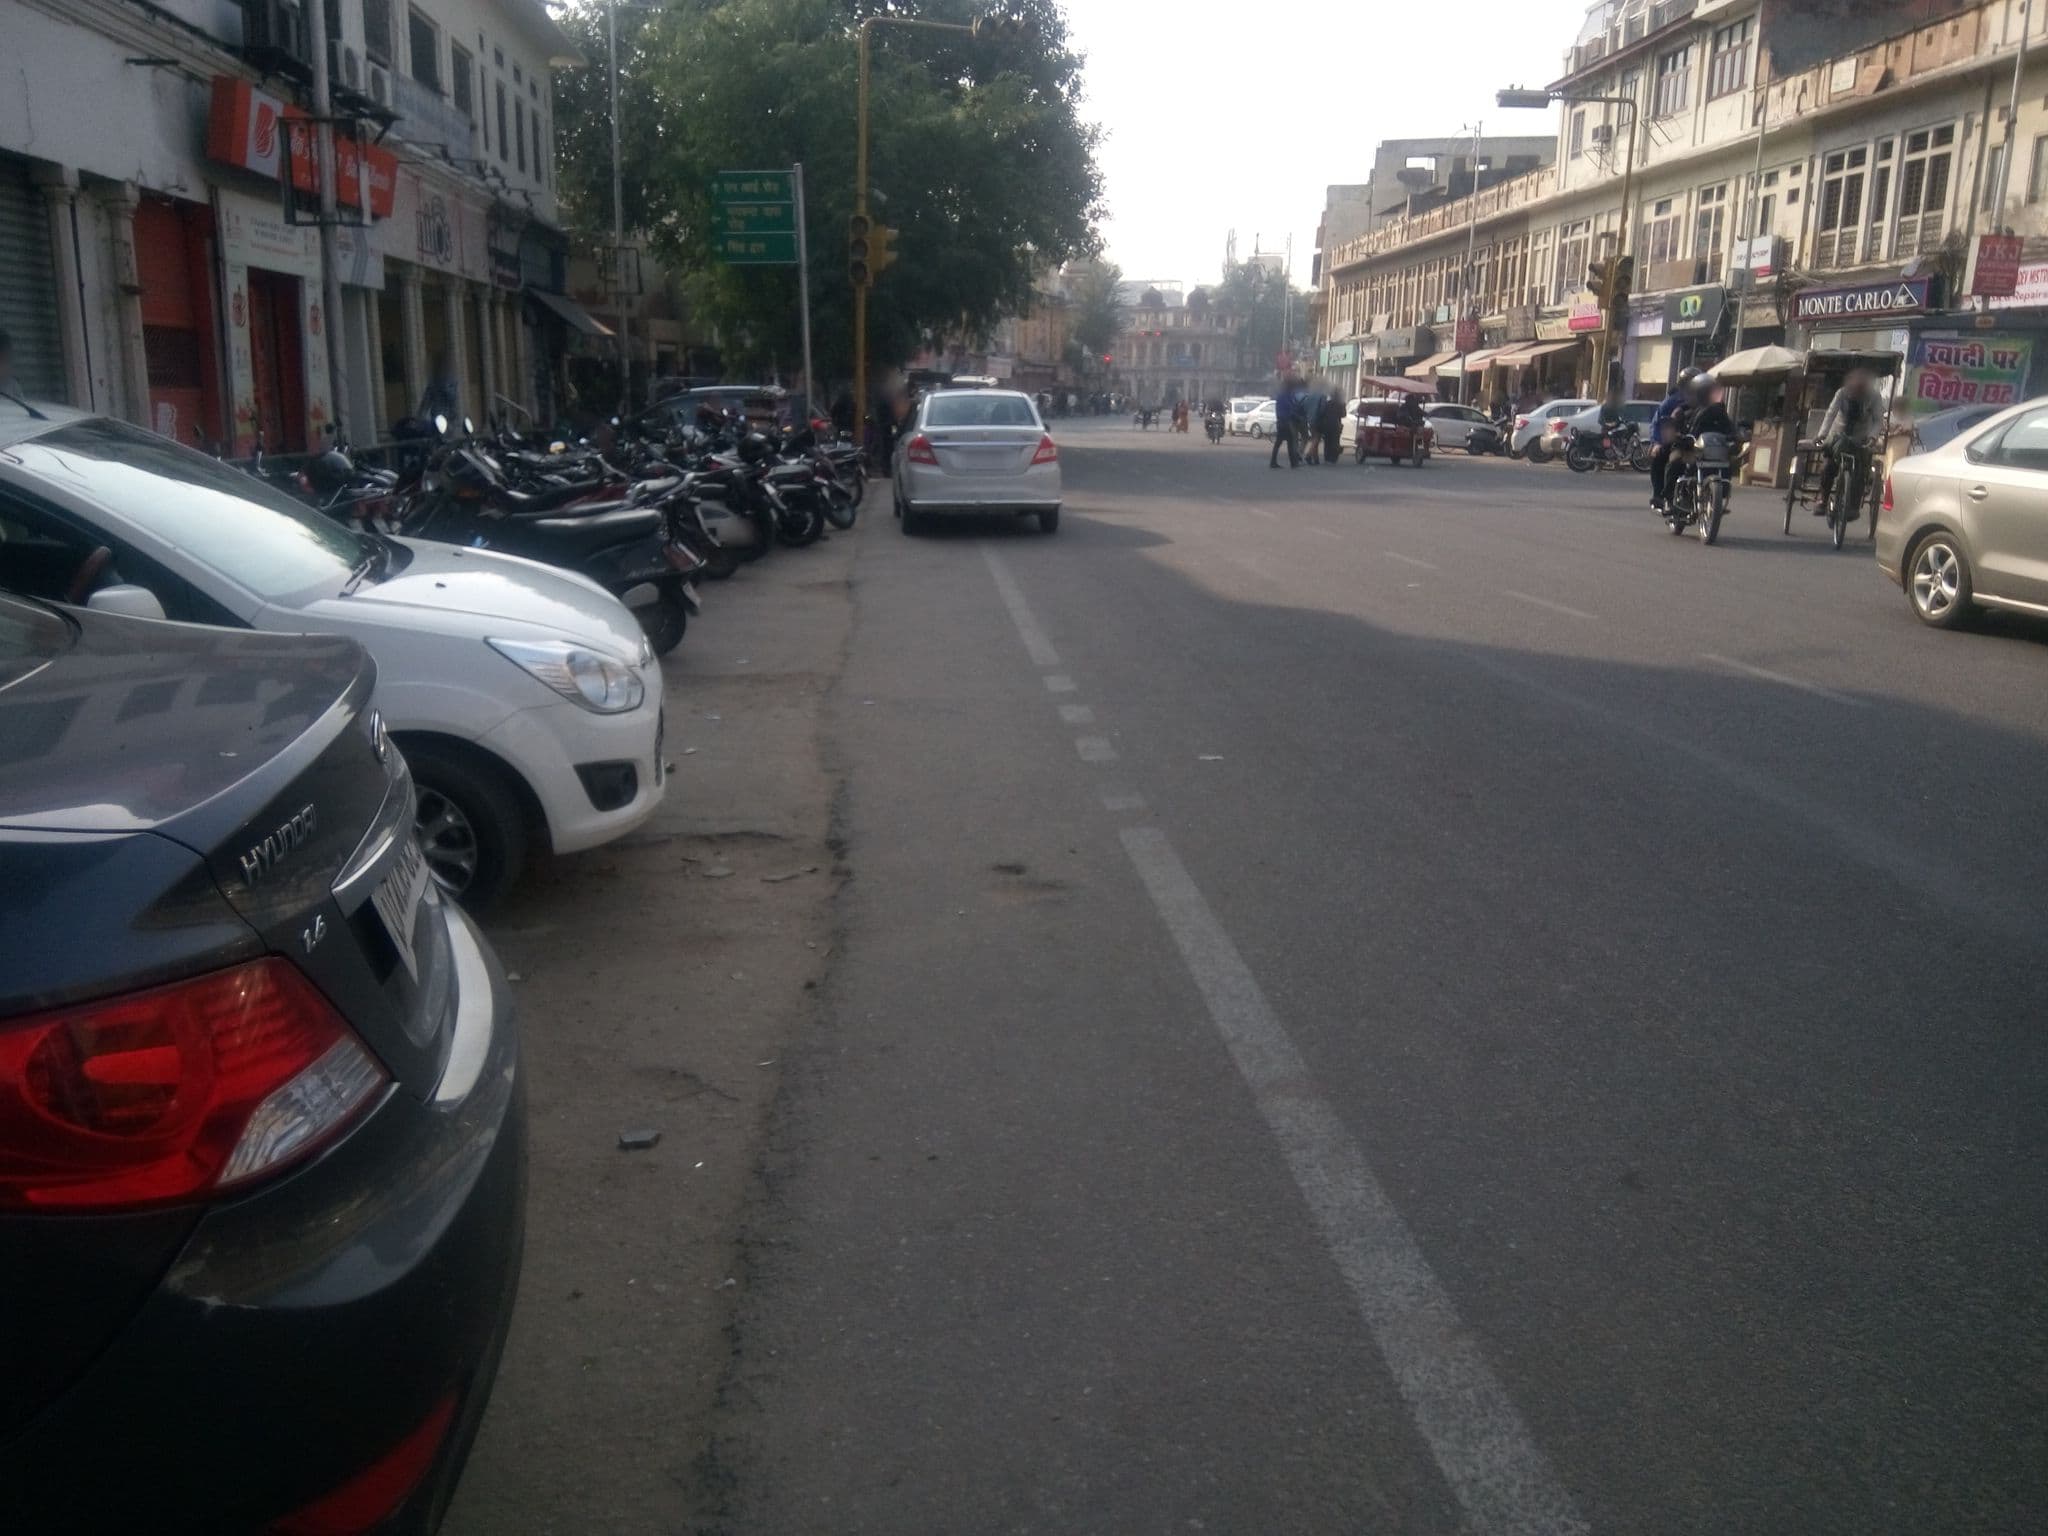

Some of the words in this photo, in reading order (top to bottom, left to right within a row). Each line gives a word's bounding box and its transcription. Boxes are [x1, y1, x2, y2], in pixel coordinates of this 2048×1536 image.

[1798, 295, 1842, 317] MONTE
[1845, 289, 1891, 312] CARLO
[1992, 349, 2021, 370] पर
[1917, 372, 1978, 401] विशेष
[239, 803, 318, 885] HYUNDAI
[303, 914, 327, 953] 1.6
